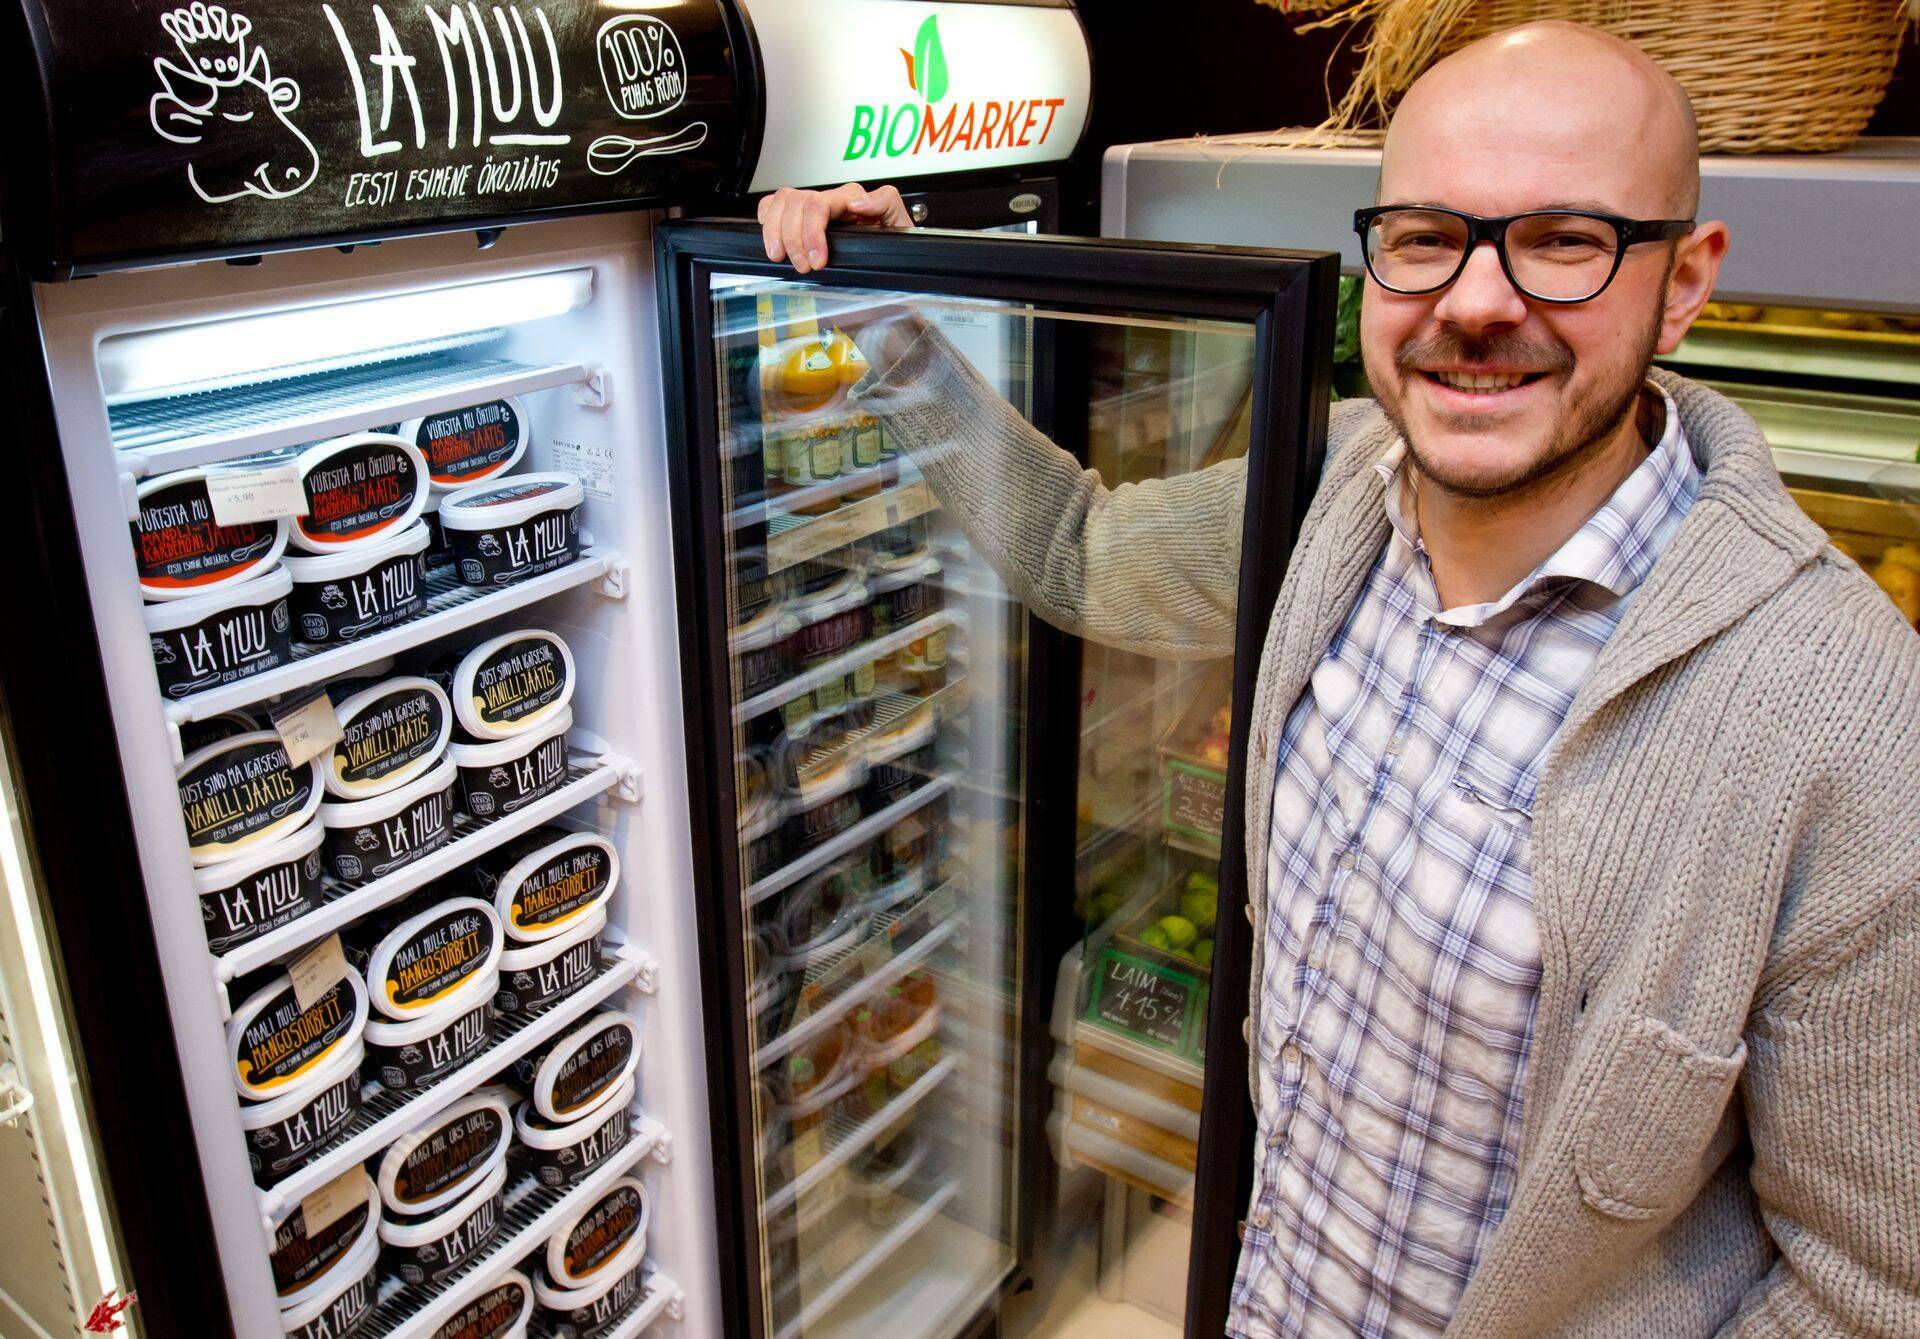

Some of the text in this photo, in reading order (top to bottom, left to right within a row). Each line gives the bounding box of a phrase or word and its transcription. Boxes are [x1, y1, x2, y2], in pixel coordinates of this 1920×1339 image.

[323, 1, 566, 157] LA MUU
[605, 25, 675, 85] 100%
[620, 80, 654, 111] PUHAS
[843, 98, 1064, 161] BIOMARKET
[345, 155, 561, 208] EESTI ESIMENE ÖKOJÄÄTIS
[463, 412, 475, 430] MU
[353, 462, 366, 482] MU
[191, 499, 208, 520] MU
[506, 514, 566, 568] LA MUU
[351, 558, 414, 620] LA MUU
[180, 628, 217, 677] LA
[219, 609, 267, 668] MUU
[479, 667, 498, 688] JUST
[497, 660, 512, 680] SIND
[511, 655, 523, 674] MA
[344, 723, 367, 747] JUST
[365, 714, 381, 737] SIND
[382, 709, 395, 728] MA
[179, 780, 205, 808] JUST
[204, 772, 227, 797] SIND
[227, 765, 244, 786] MA
[514, 757, 536, 795] LA
[538, 736, 562, 785] MUU
[384, 794, 443, 858] LA MUU
[219, 863, 301, 931] LA MUU
[522, 873, 545, 896] MAALI
[547, 861, 571, 883] MULLE
[396, 943, 421, 970] MAALI
[423, 928, 448, 954] MULLE
[538, 962, 560, 996] LA
[563, 940, 591, 986] MUU
[1110, 962, 1157, 994] LAIM
[246, 1019, 275, 1048] MAALI
[427, 1033, 452, 1069] LA
[454, 1006, 485, 1057] MUU
[283, 1112, 312, 1151] LA
[314, 1080, 348, 1136] MUU
[580, 1108, 624, 1167] LA MUU
[442, 1197, 495, 1263] LA MUU
[333, 1278, 366, 1335] MUU
[593, 1268, 636, 1324] LA MUU
